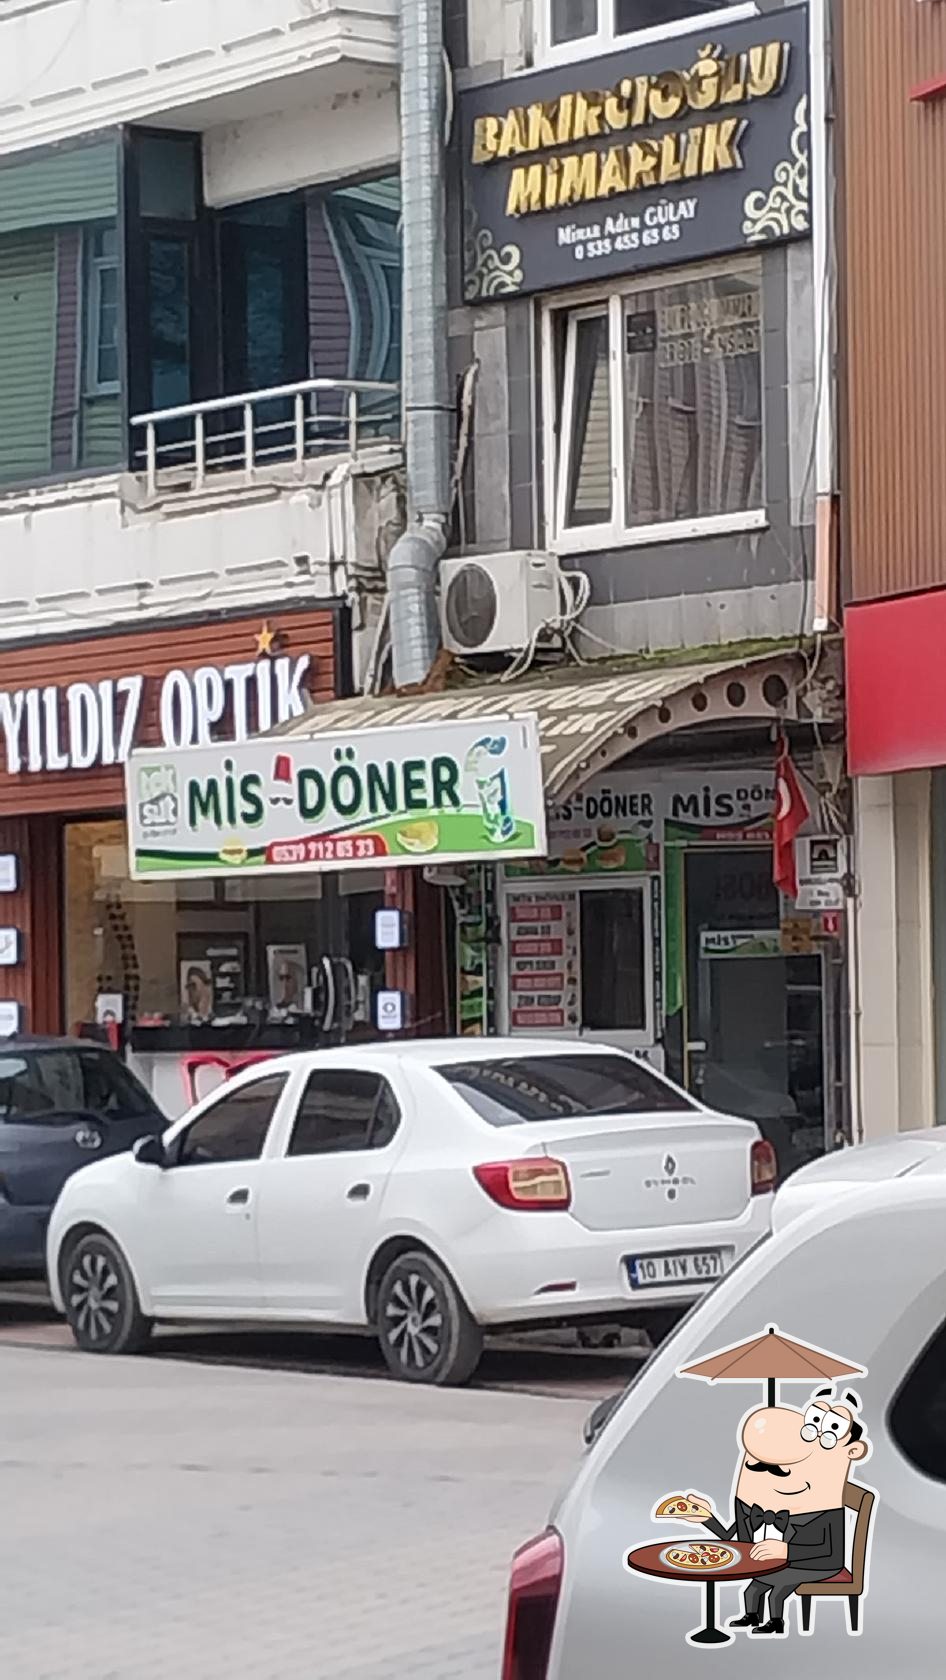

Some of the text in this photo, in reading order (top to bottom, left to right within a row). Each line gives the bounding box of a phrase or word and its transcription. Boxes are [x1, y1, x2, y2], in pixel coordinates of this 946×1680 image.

[505, 118, 745, 216] MİMARLIK
[644, 199, 698, 226] GÜLAY
[0, 674, 143, 775] YILDIZ
[187, 758, 265, 830] MİS
[297, 746, 462, 822] DÖNER
[585, 788, 654, 820] DÖNER
[671, 786, 734, 818] MİS
[639, 1260, 657, 1280] 10
